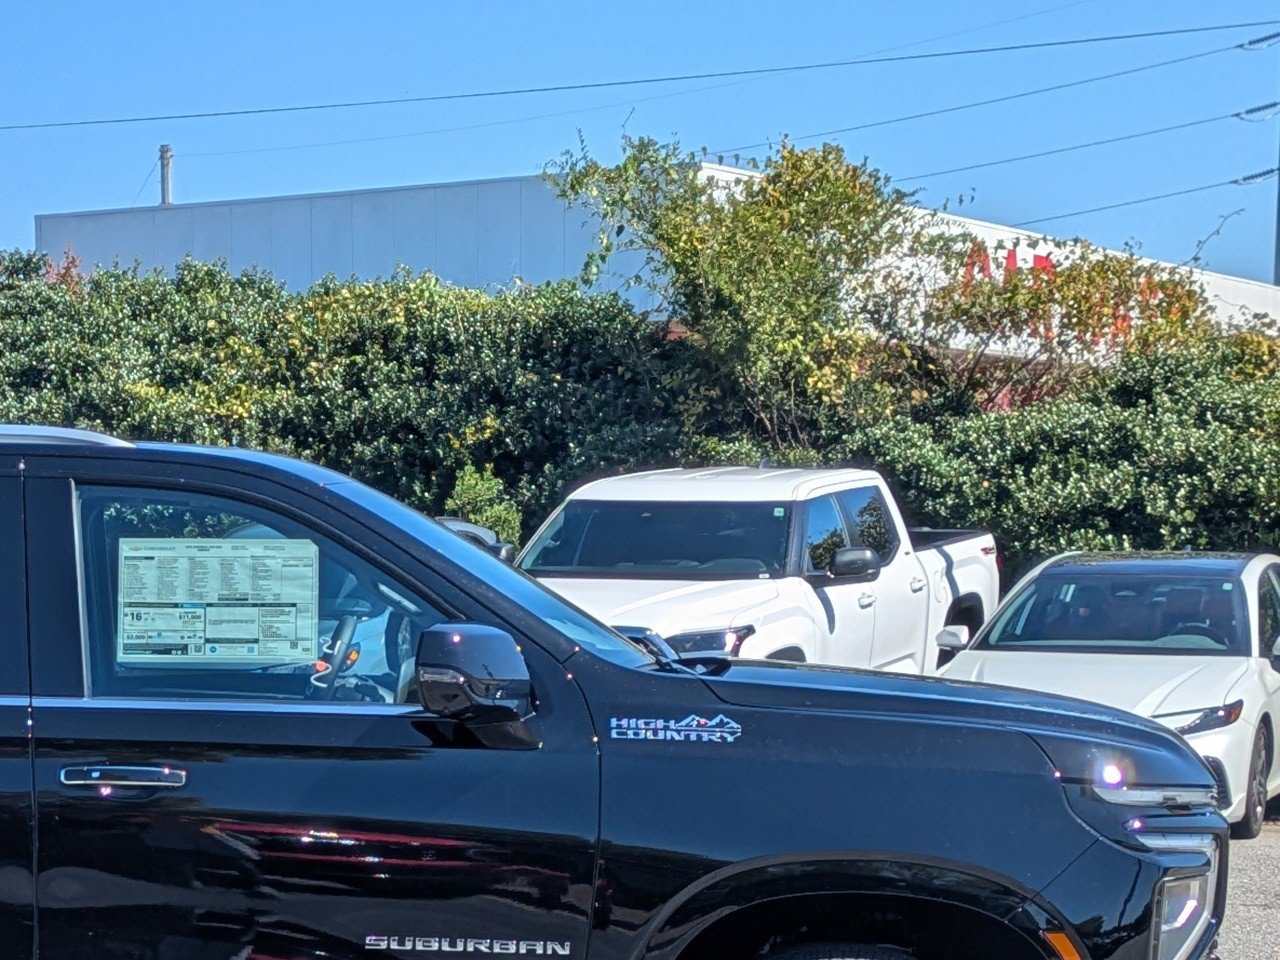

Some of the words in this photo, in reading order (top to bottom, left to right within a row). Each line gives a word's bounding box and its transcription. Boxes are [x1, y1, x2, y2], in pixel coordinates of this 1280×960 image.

[129, 612, 142, 621] 16
[610, 717, 677, 729] HIGH
[610, 729, 742, 743] COUNTRY
[364, 935, 571, 955] SUBURBAN
